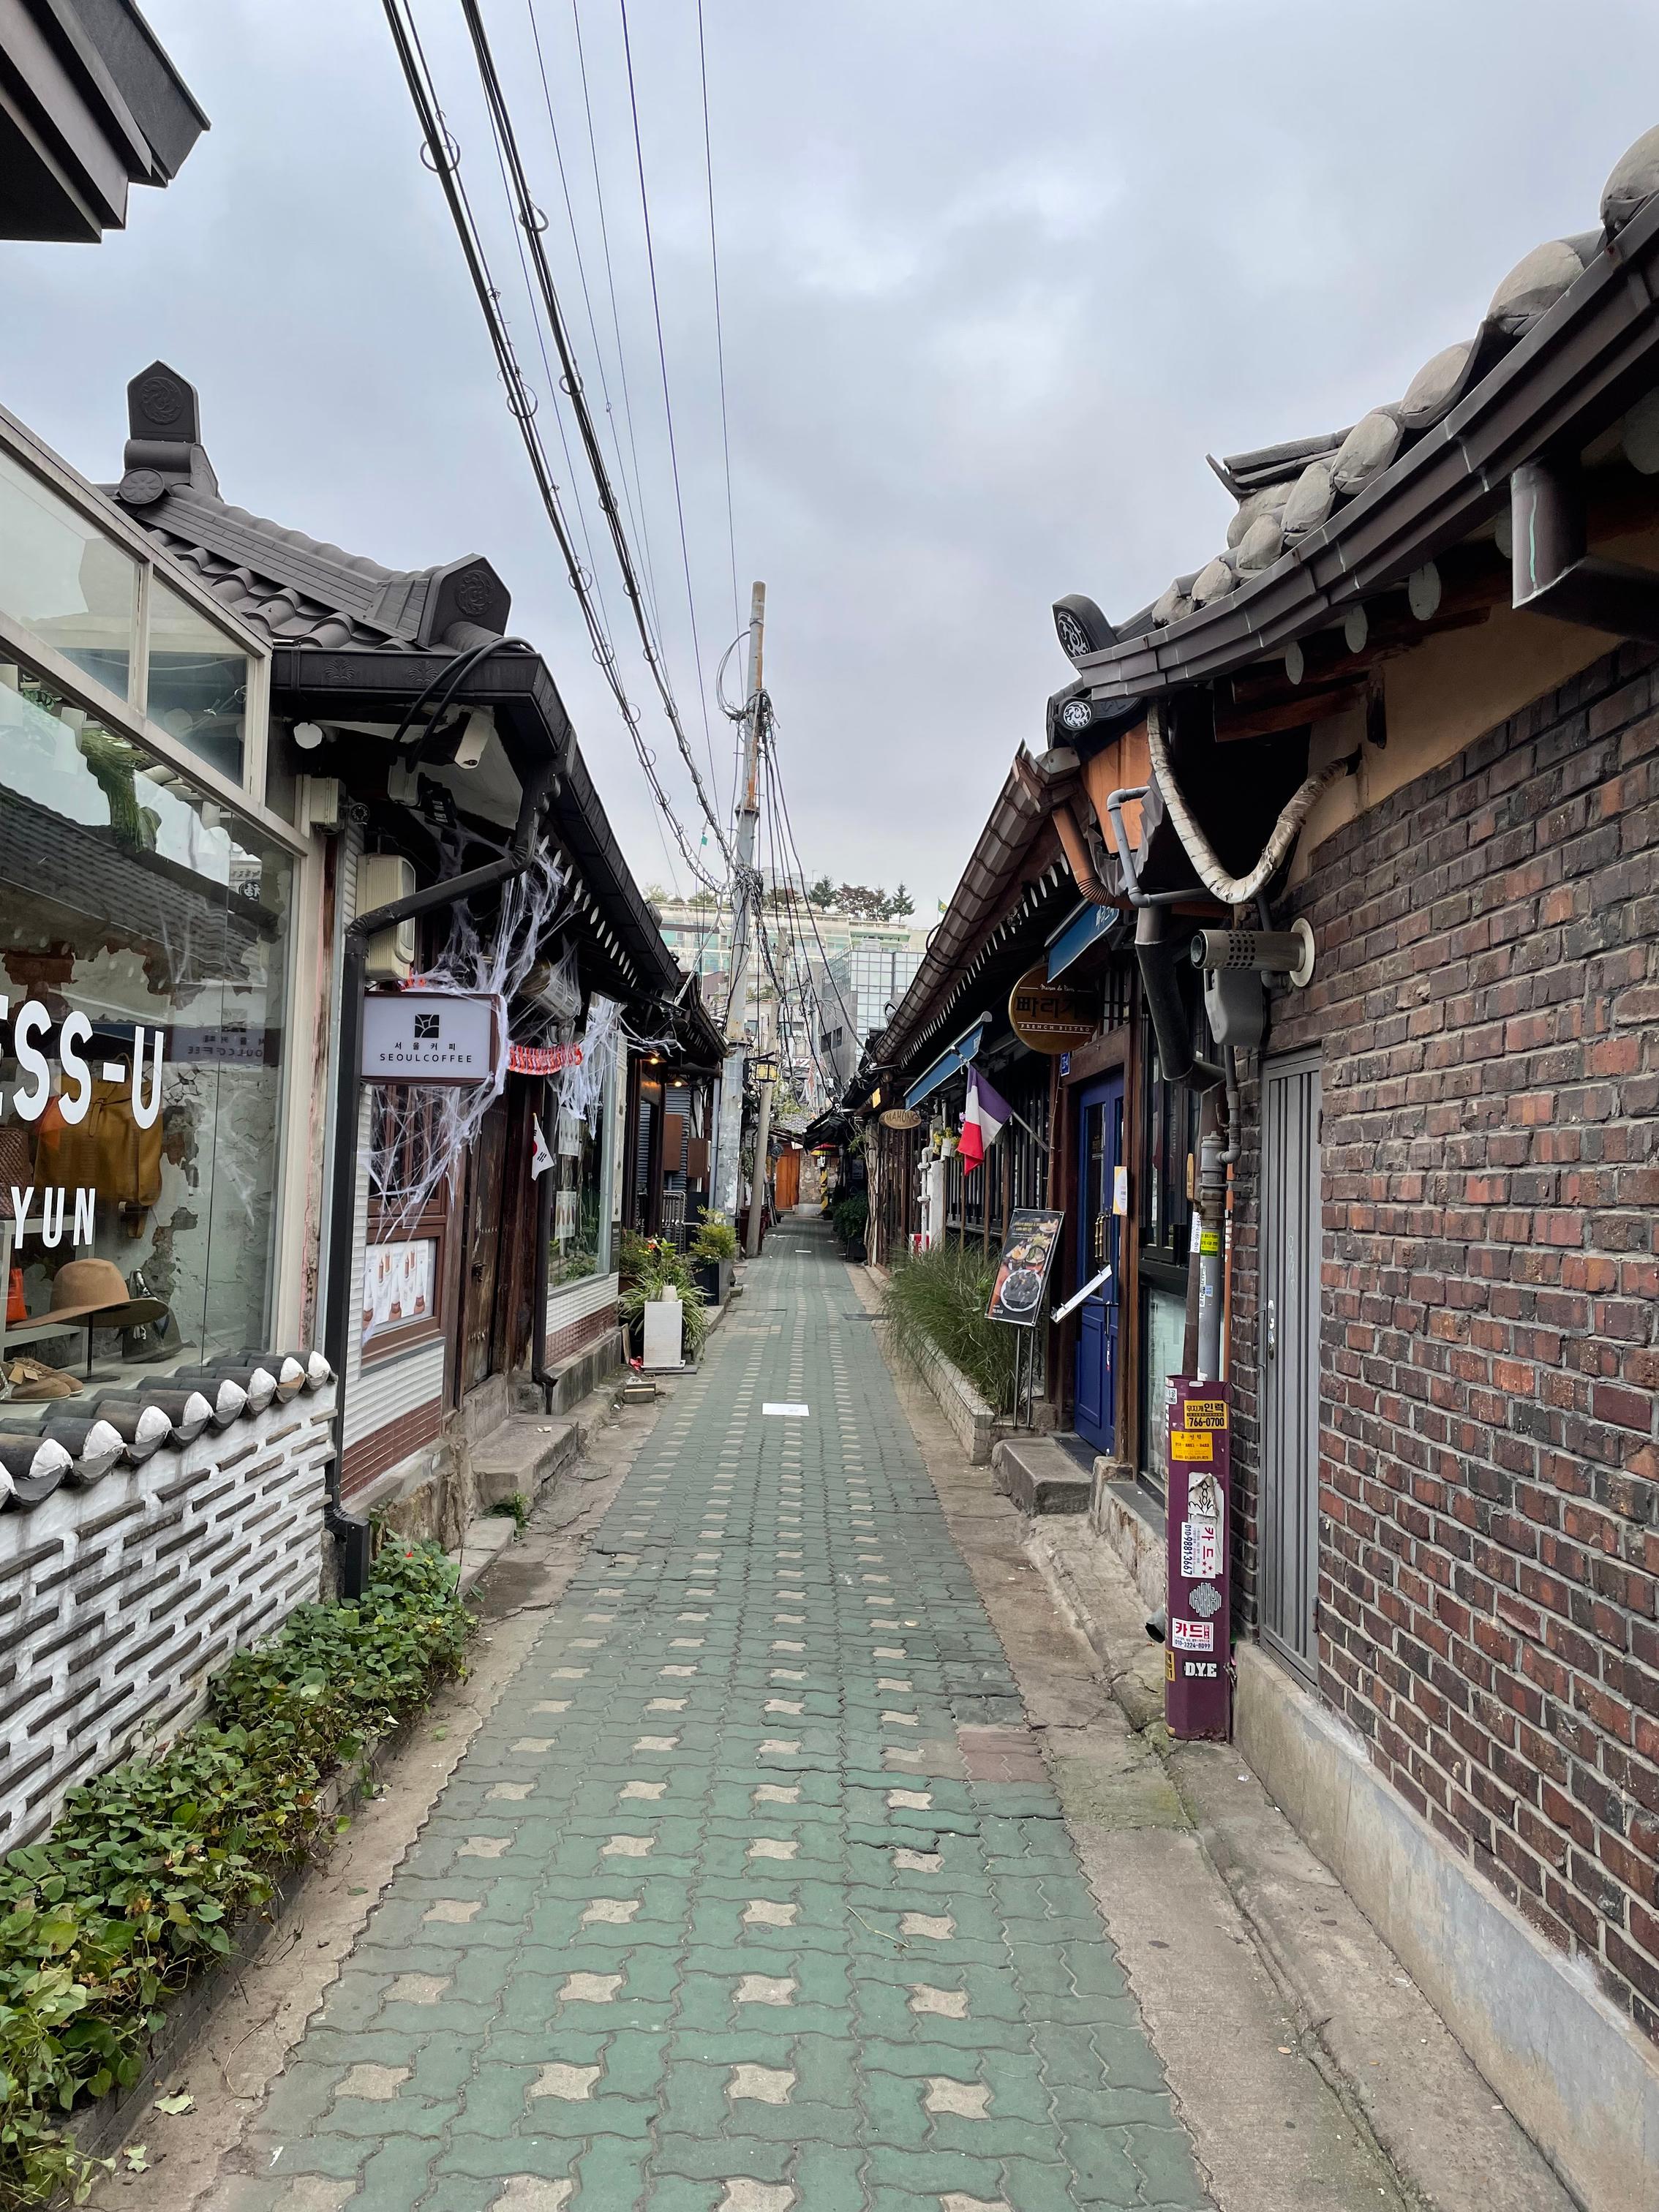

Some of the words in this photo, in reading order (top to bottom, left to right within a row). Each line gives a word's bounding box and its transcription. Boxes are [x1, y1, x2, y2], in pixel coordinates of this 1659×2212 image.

[0, 994, 165, 1129] SS-U
[380, 1053, 473, 1063] SEOULCOFFEE
[10, 1186, 96, 1249] YUN
[1189, 1417, 1224, 1427] 766-0700
[1175, 1622, 1203, 1638] 카드
[1184, 1661, 1217, 1677] D.Y.E
